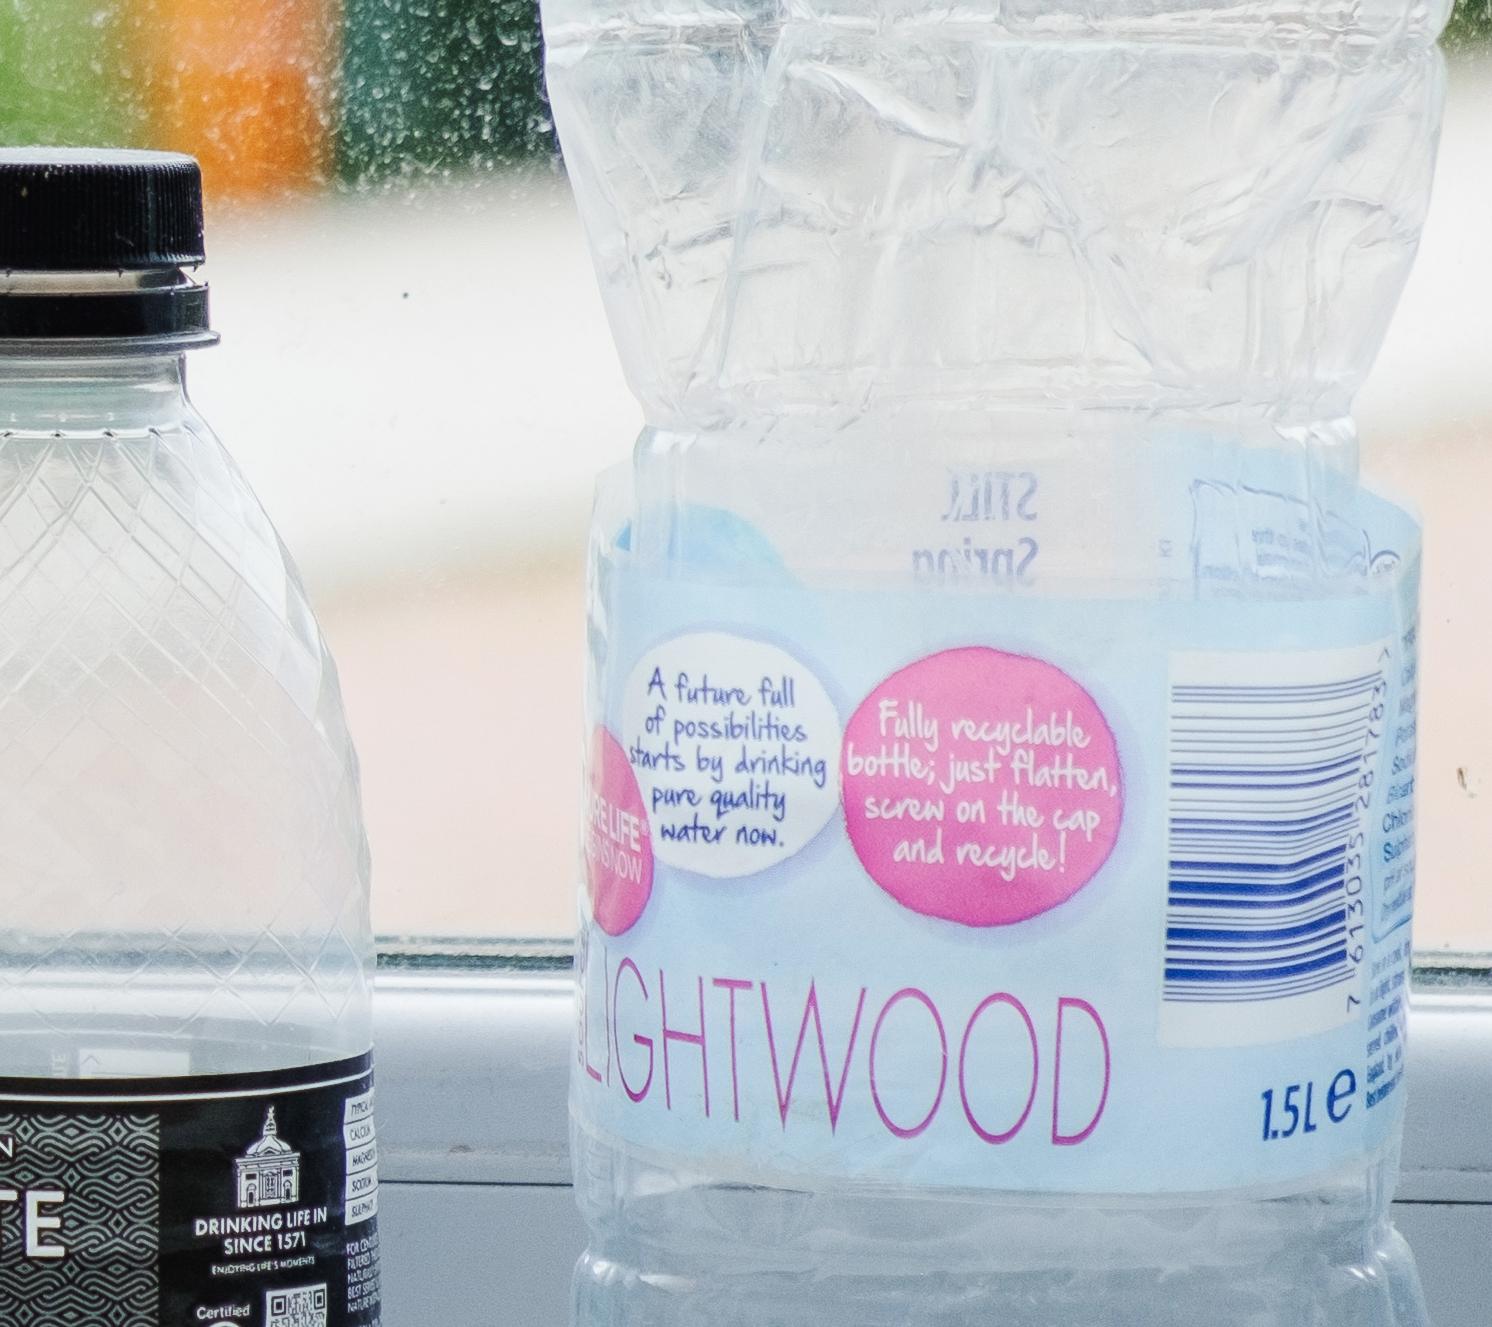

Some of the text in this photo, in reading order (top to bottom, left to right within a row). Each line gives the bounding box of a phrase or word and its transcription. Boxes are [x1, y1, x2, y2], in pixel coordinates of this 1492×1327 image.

[648, 666, 795, 707] A future full
[645, 704, 808, 746] of possibilities
[878, 699, 1091, 756] Fully recyclable
[630, 736, 826, 789] starts by drinking
[847, 742, 1116, 798] bottle; just flatten,
[652, 778, 785, 822] pure quality
[864, 790, 1100, 842] screw on the cap
[661, 811, 784, 847] water now.
[893, 827, 1066, 882] and recycle!
[1260, 1080, 1317, 1143] 1.5L
[195, 1206, 327, 1237] DRINKING LIFE IN
[224, 1231, 306, 1255] SINCE 1571
[196, 1303, 250, 1320] Certified
